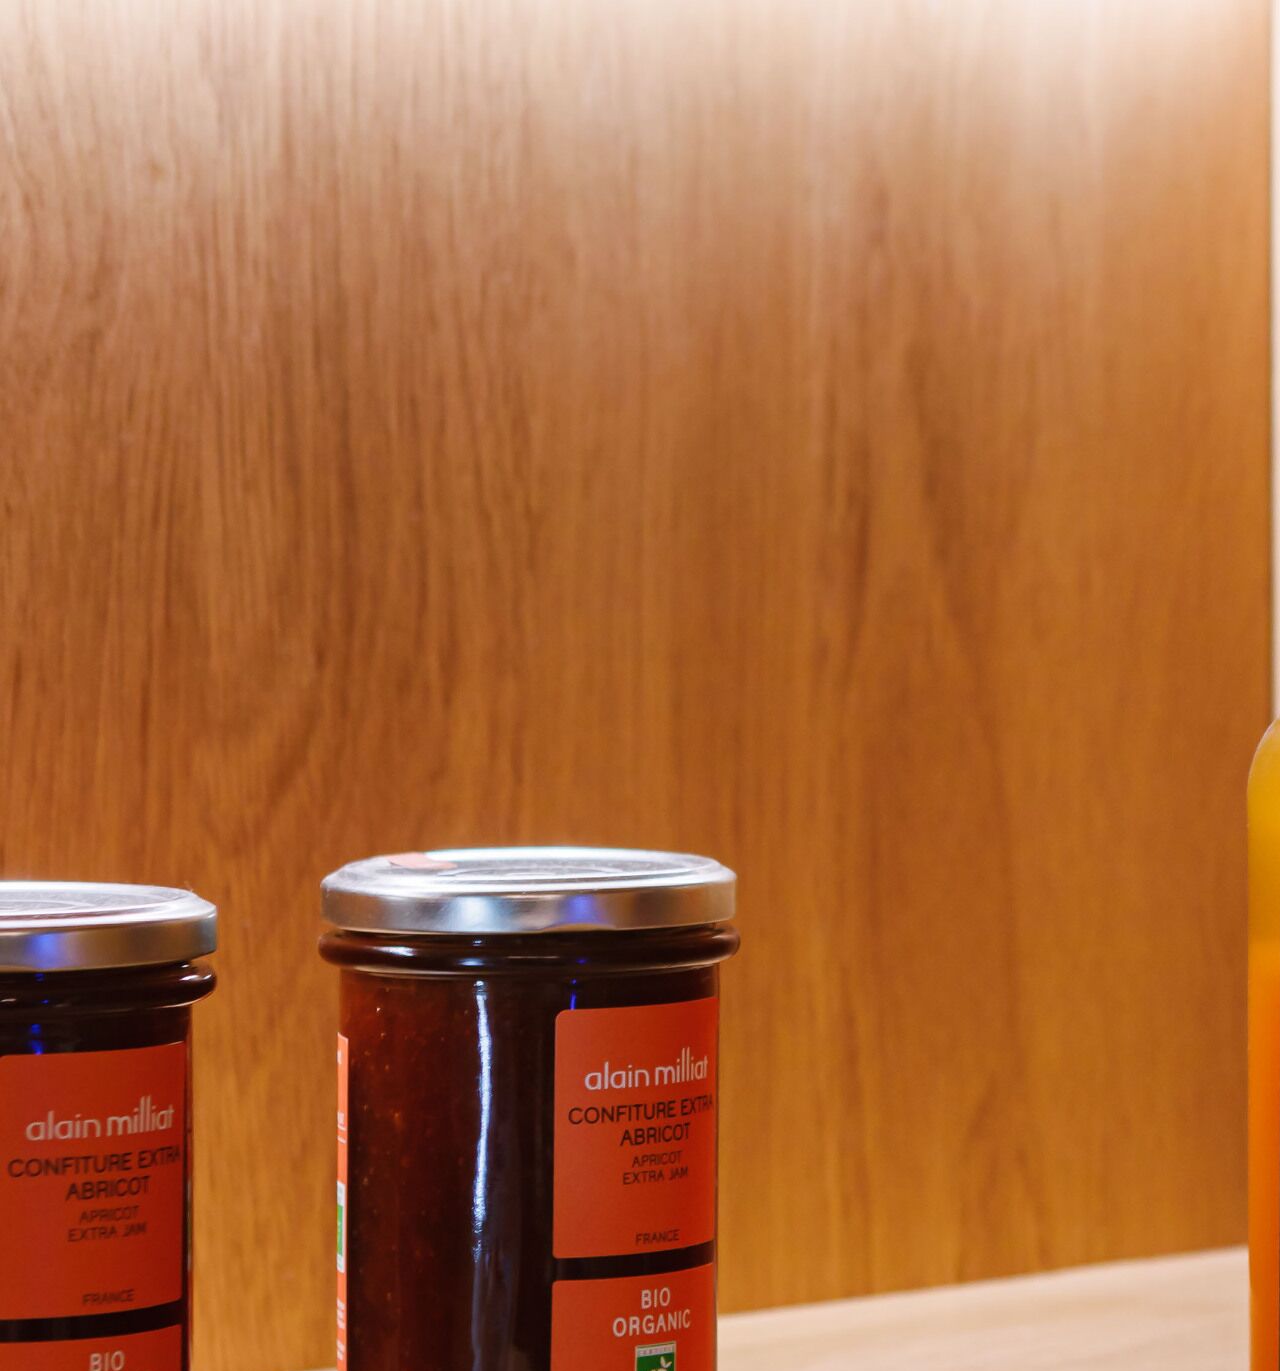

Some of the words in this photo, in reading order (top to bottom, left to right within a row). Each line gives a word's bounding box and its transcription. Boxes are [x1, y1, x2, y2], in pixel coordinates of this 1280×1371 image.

[584, 1061, 650, 1090] alain
[655, 1047, 708, 1086] milliat
[26, 1111, 101, 1141] alain
[106, 1096, 175, 1137] milliat
[568, 1100, 676, 1124] CONFITURE
[620, 1123, 690, 1146] ABRICOT
[8, 1152, 132, 1178] CONFITURE
[632, 1151, 682, 1168] APRICOT
[623, 1171, 664, 1186] EXTRA
[669, 1167, 688, 1181] JAM
[66, 1176, 151, 1200] ABRICOT
[79, 1205, 140, 1224] APRICOT
[67, 1226, 118, 1242] EXTRA
[123, 1222, 147, 1237] JAM
[636, 1229, 679, 1245] FRANCE
[83, 1288, 135, 1305] FRANCE
[641, 1287, 670, 1309] BIO
[613, 1309, 691, 1337] ORGANIC
